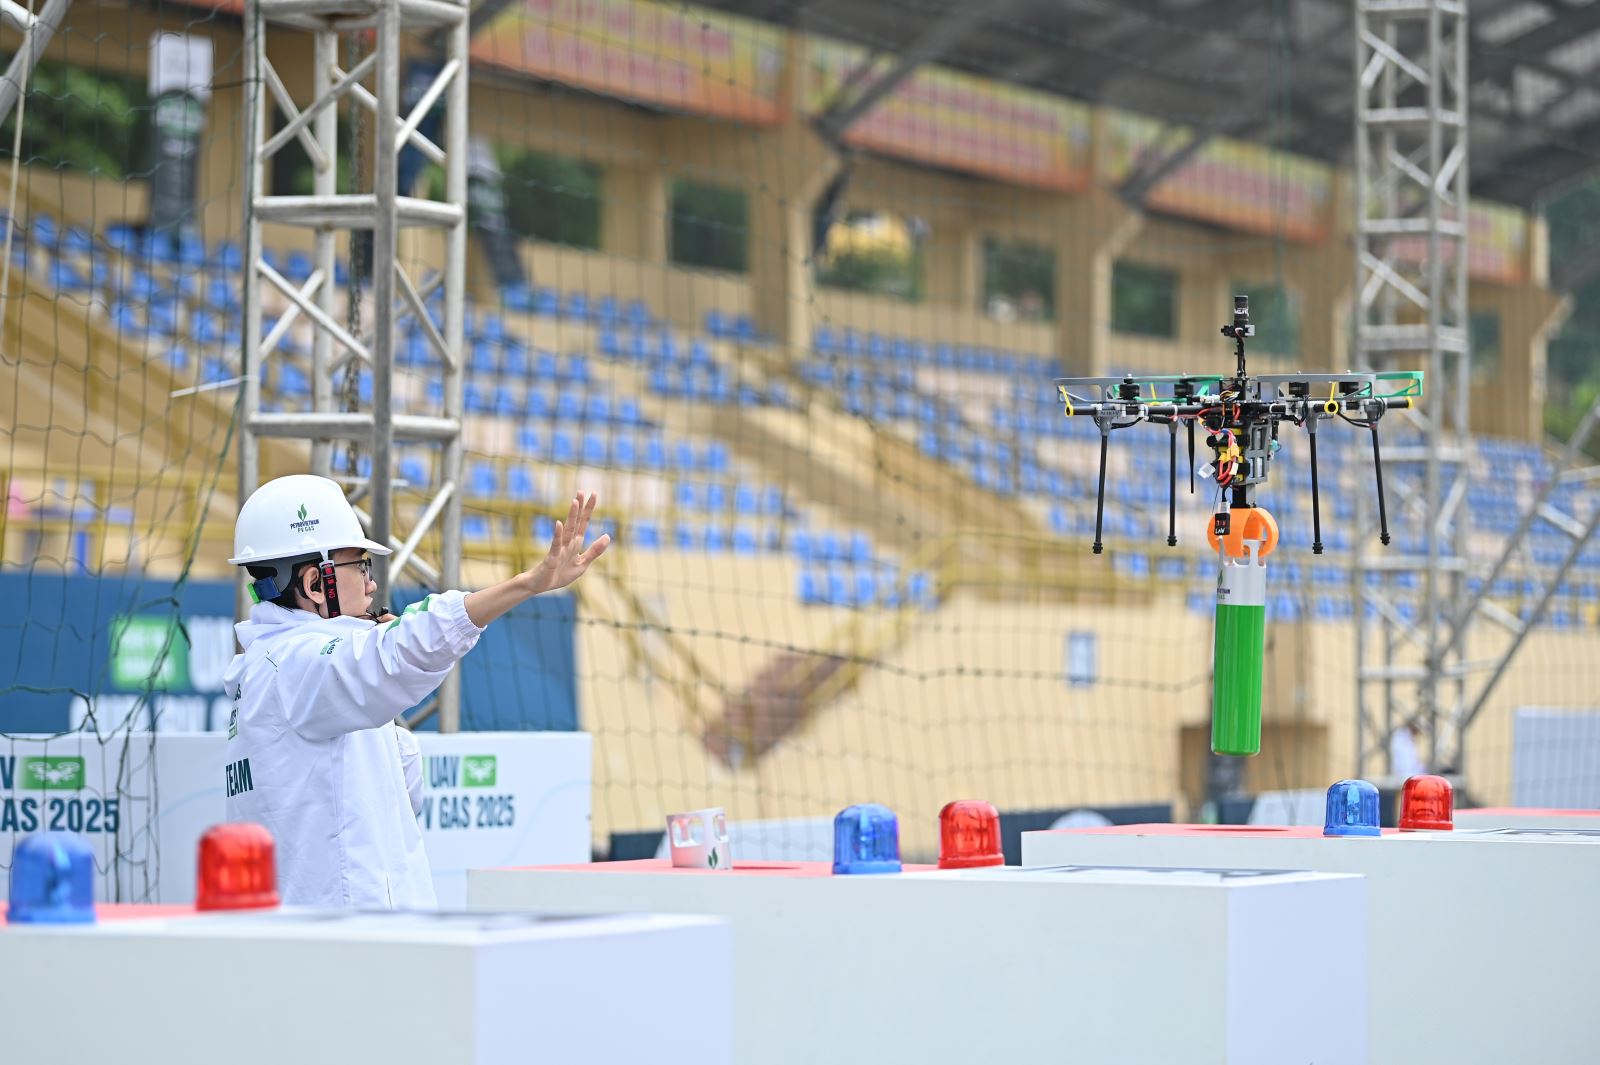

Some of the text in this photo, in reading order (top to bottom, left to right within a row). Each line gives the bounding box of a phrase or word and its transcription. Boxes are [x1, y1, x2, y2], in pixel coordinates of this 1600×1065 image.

[226, 758, 253, 797] TEAM
[430, 756, 459, 788] UAV
[49, 798, 119, 833] 2025
[440, 796, 470, 829] GAS
[477, 795, 515, 827] 2025
